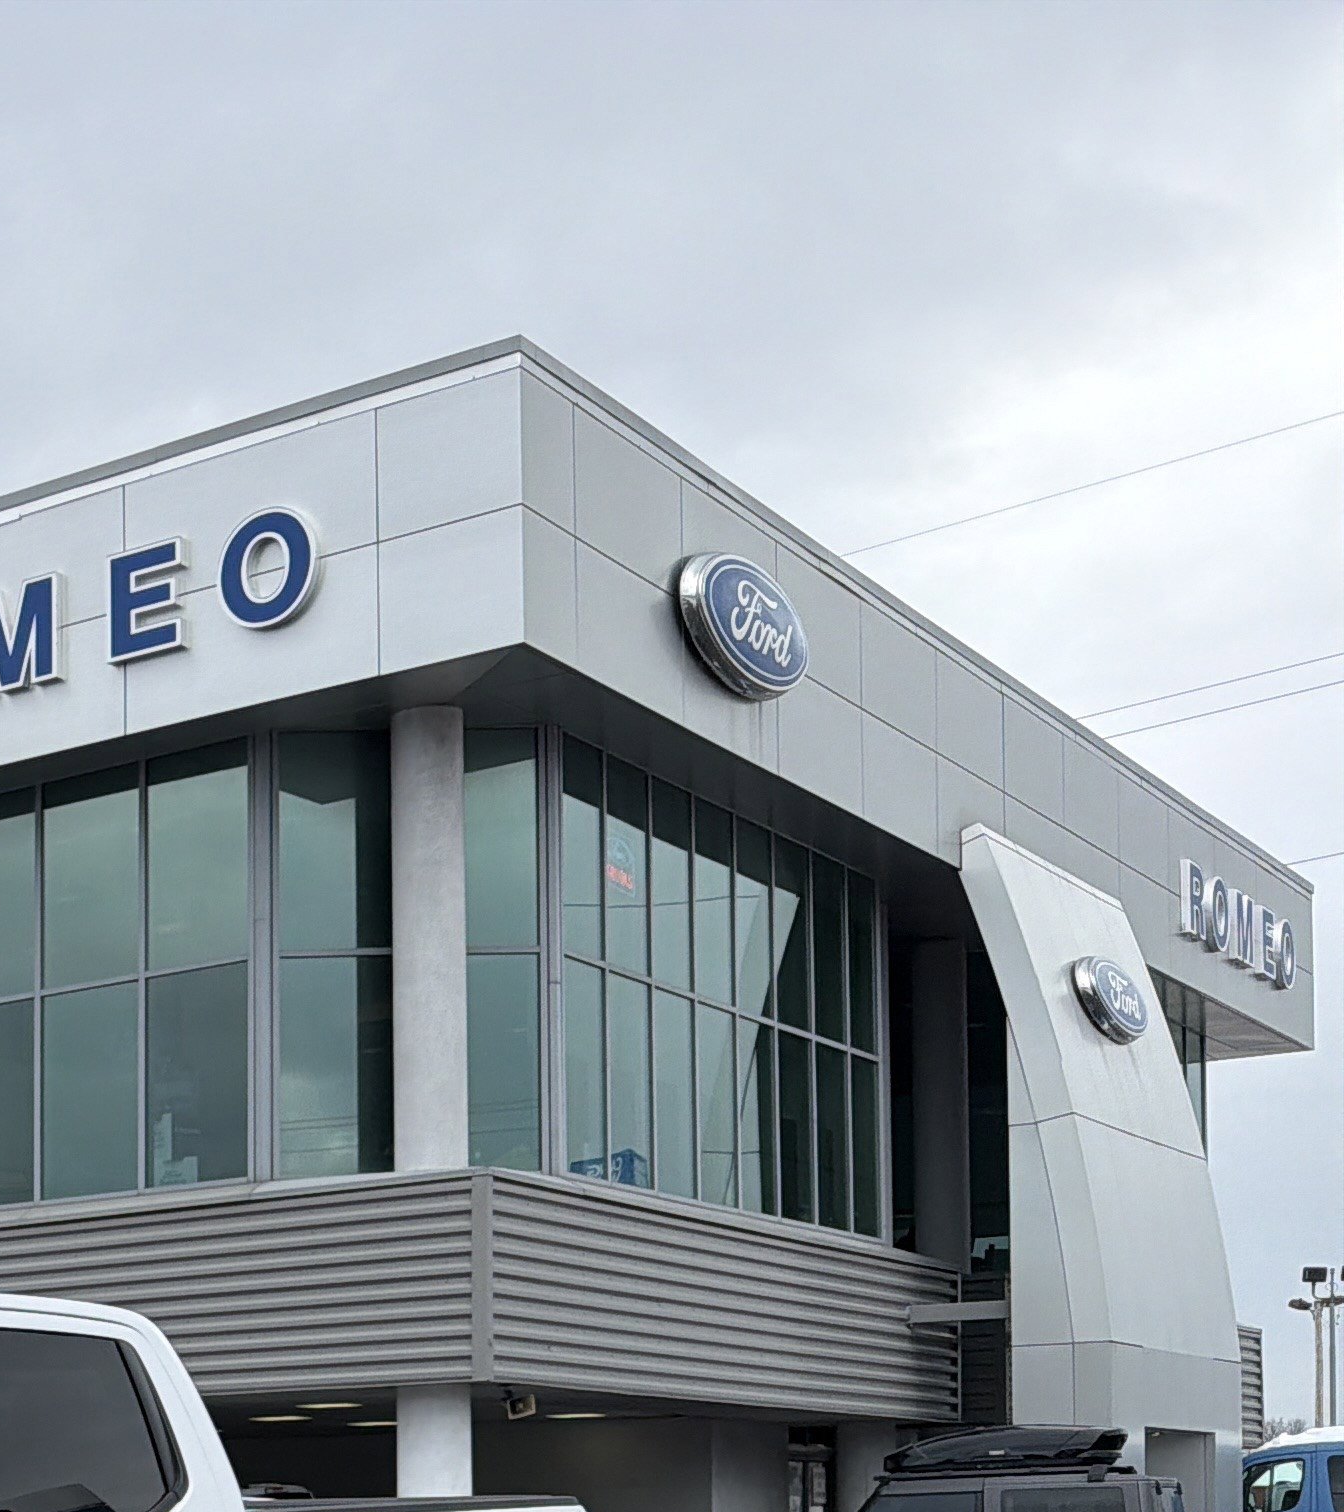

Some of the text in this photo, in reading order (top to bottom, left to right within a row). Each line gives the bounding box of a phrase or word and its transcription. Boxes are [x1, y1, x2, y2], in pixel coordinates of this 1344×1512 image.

[730, 579, 793, 668] Ford
[1179, 858, 1297, 990] ROMEO
[1108, 969, 1142, 1021] Ford
